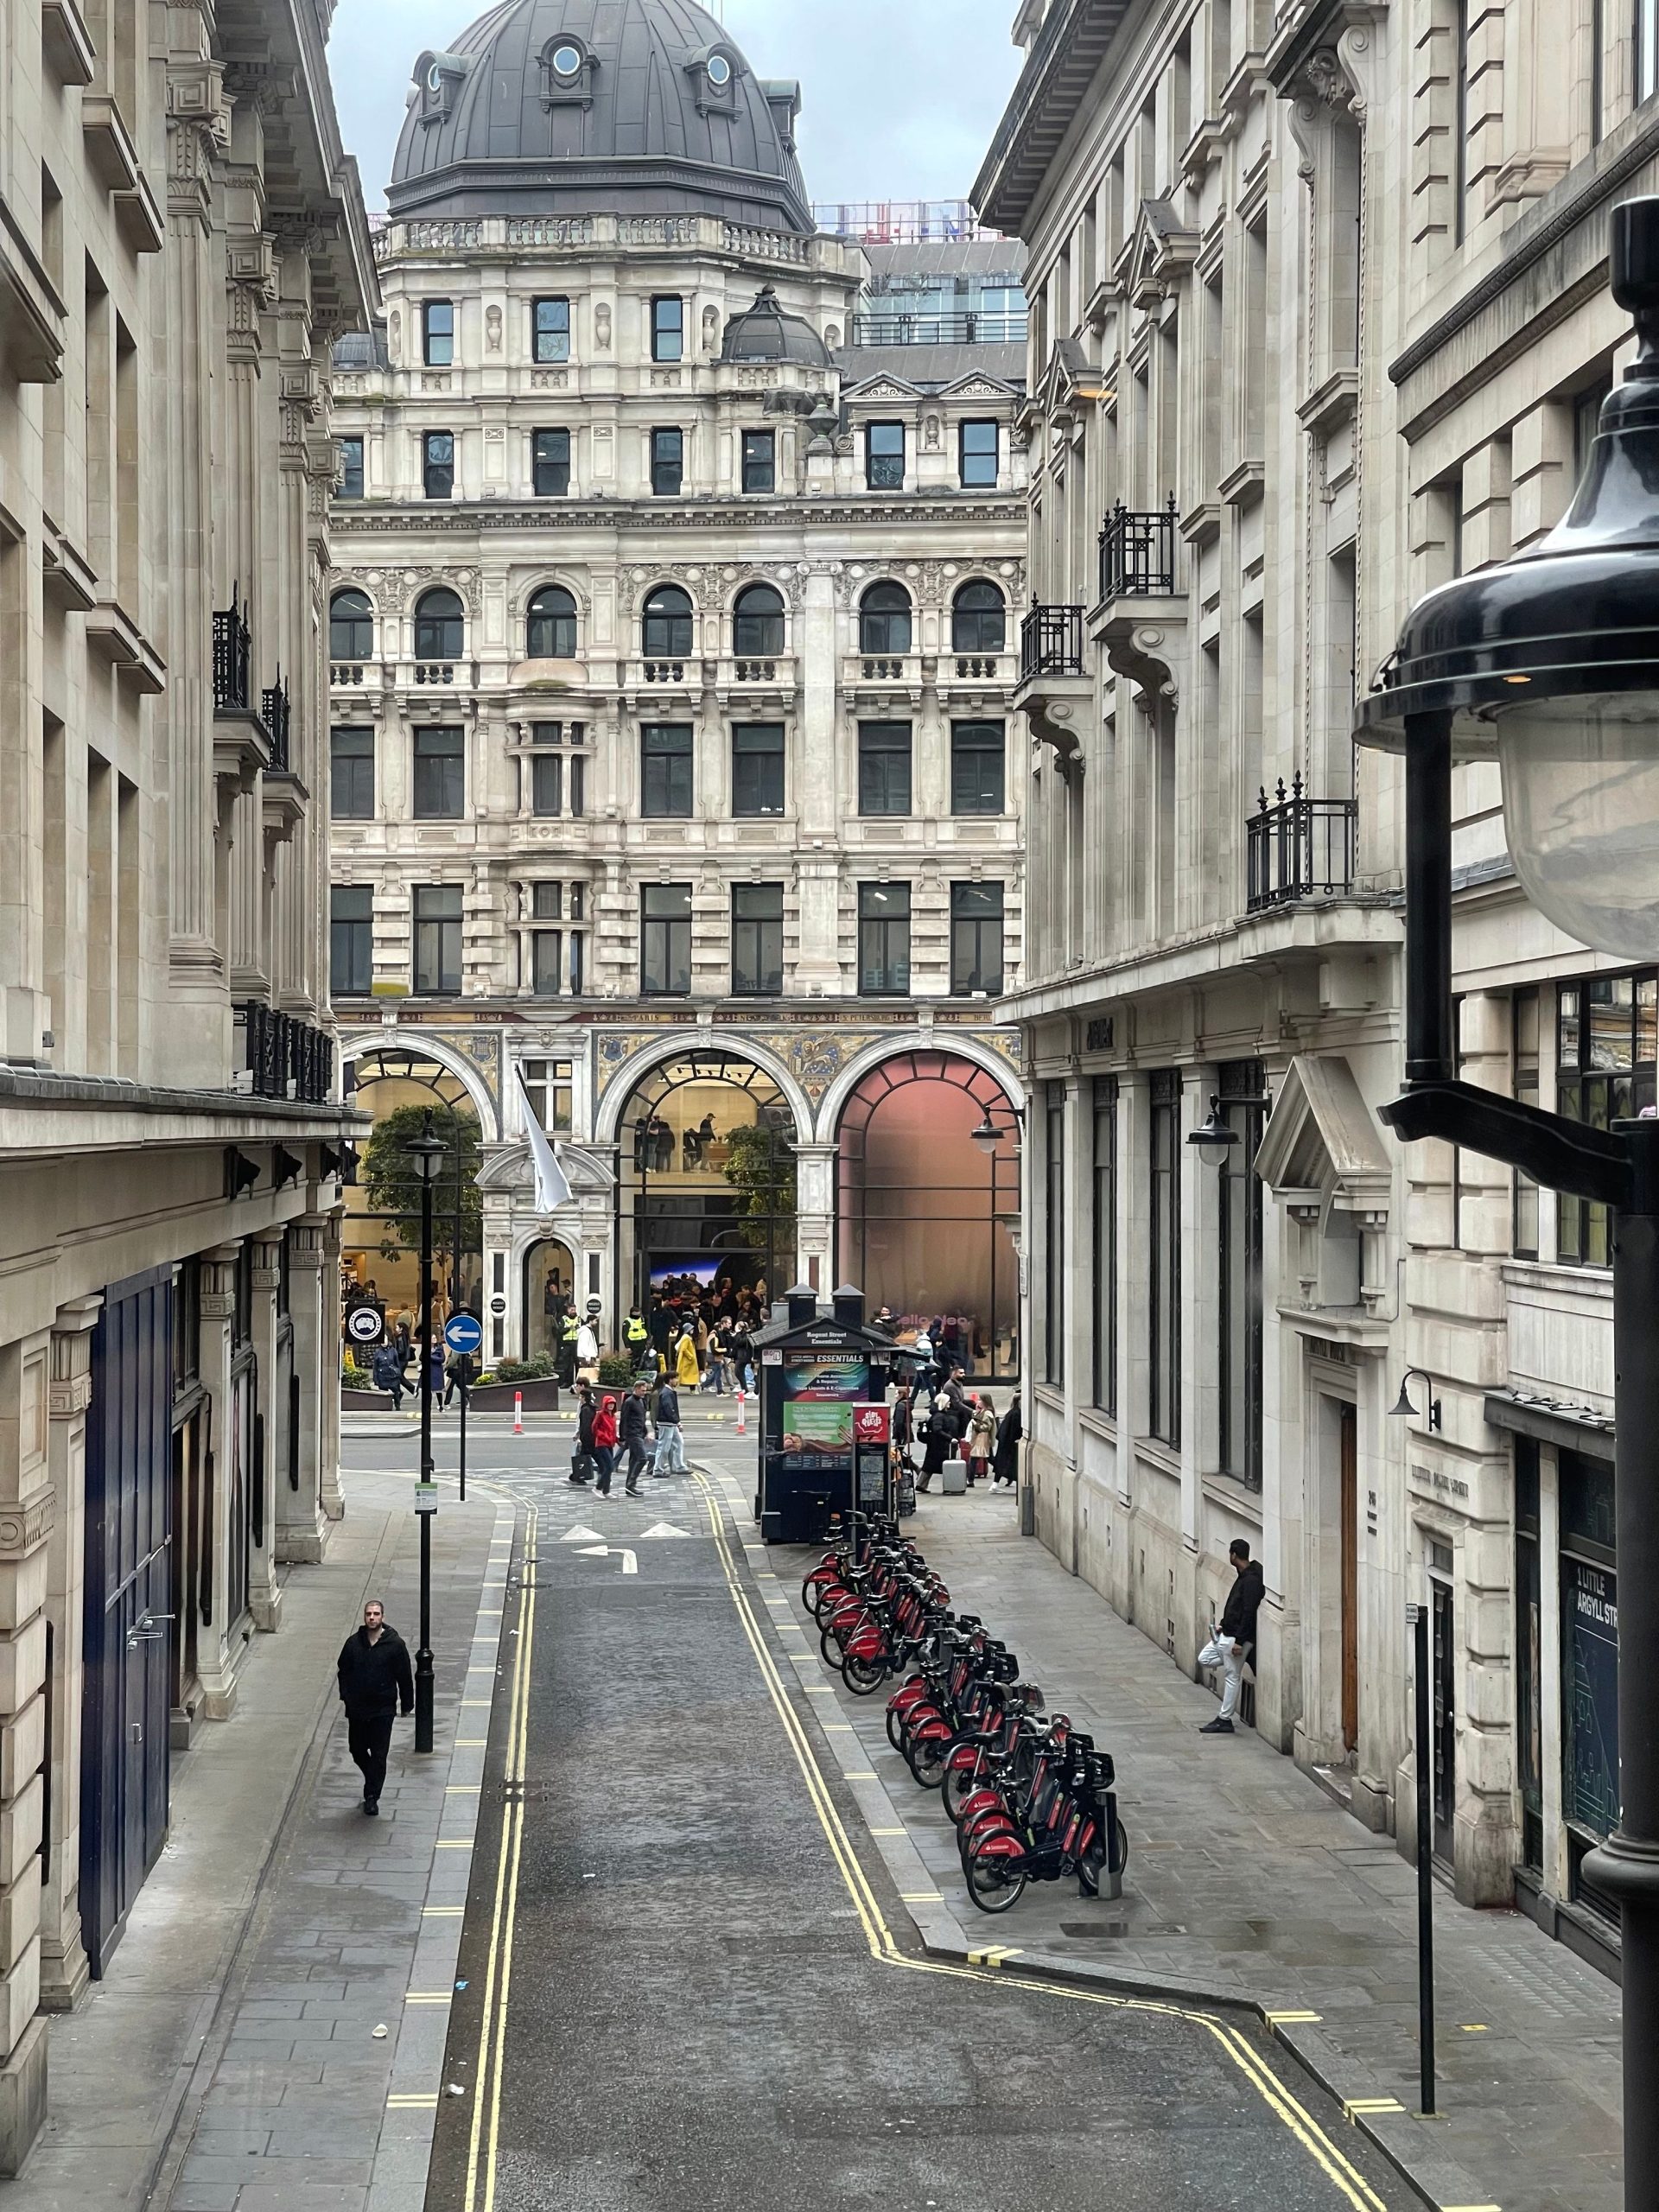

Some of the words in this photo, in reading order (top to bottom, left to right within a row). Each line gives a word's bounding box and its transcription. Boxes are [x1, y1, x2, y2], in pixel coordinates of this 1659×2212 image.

[817, 1354, 864, 1363] ESSENTIALS
[1577, 1566, 1582, 1586] 1
[1582, 1567, 1605, 1597] LITTLE
[1577, 1591, 1604, 1622] ARGYLL
